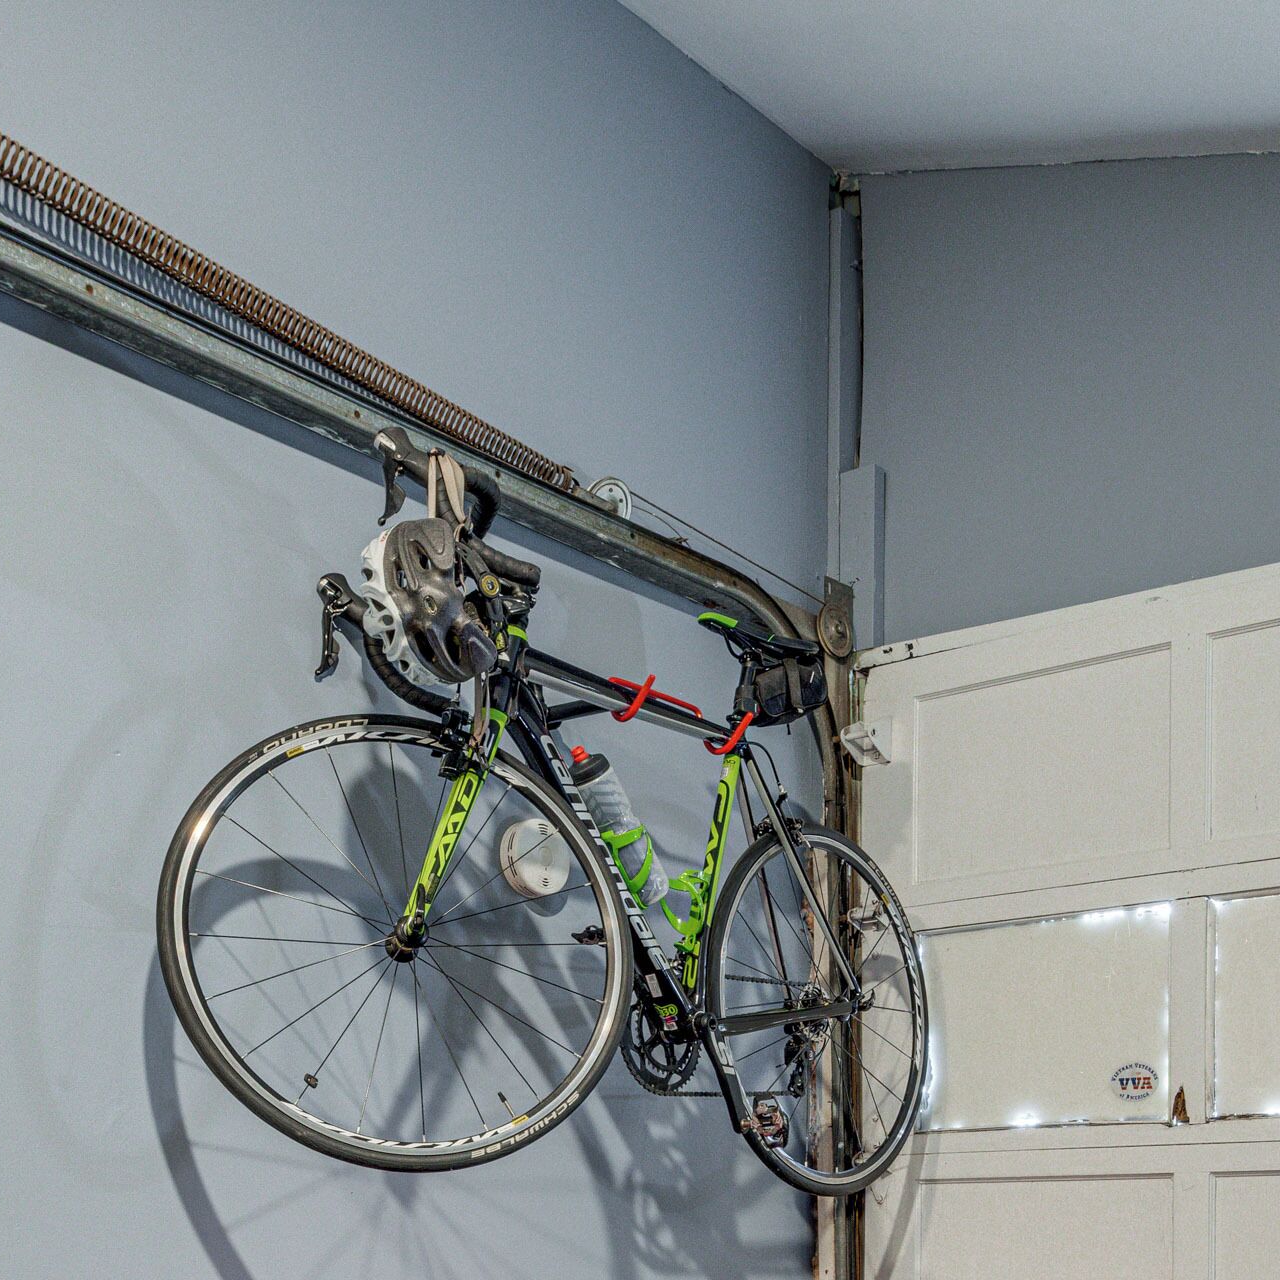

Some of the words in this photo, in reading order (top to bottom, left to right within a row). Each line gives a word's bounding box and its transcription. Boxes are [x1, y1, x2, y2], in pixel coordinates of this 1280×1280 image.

[1111, 1063, 1133, 1081] VIETNAM
[1135, 1063, 1159, 1081] VETERANS
[1119, 1076, 1153, 1090] VVA
[1126, 1092, 1150, 1100] AMERICA
[471, 1090, 581, 1159] SCHWALBE
